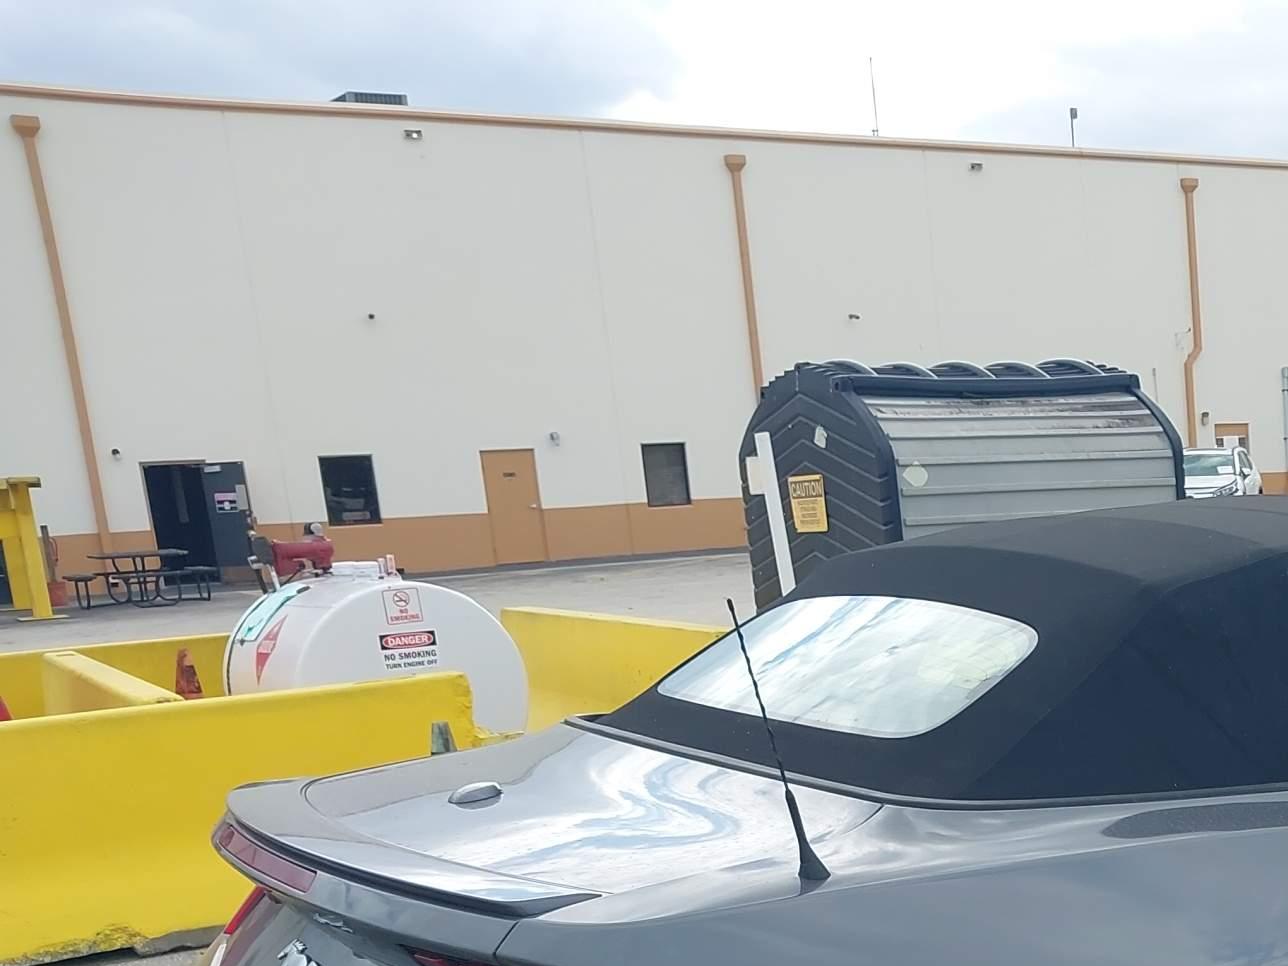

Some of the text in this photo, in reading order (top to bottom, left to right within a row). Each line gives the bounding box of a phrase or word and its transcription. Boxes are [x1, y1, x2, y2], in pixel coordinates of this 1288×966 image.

[791, 481, 822, 497] CAUTION
[390, 613, 420, 621] SMOKING
[388, 635, 428, 645] DANGER
[384, 650, 437, 662] NO SMOKING
[403, 660, 425, 668] ENGINE
